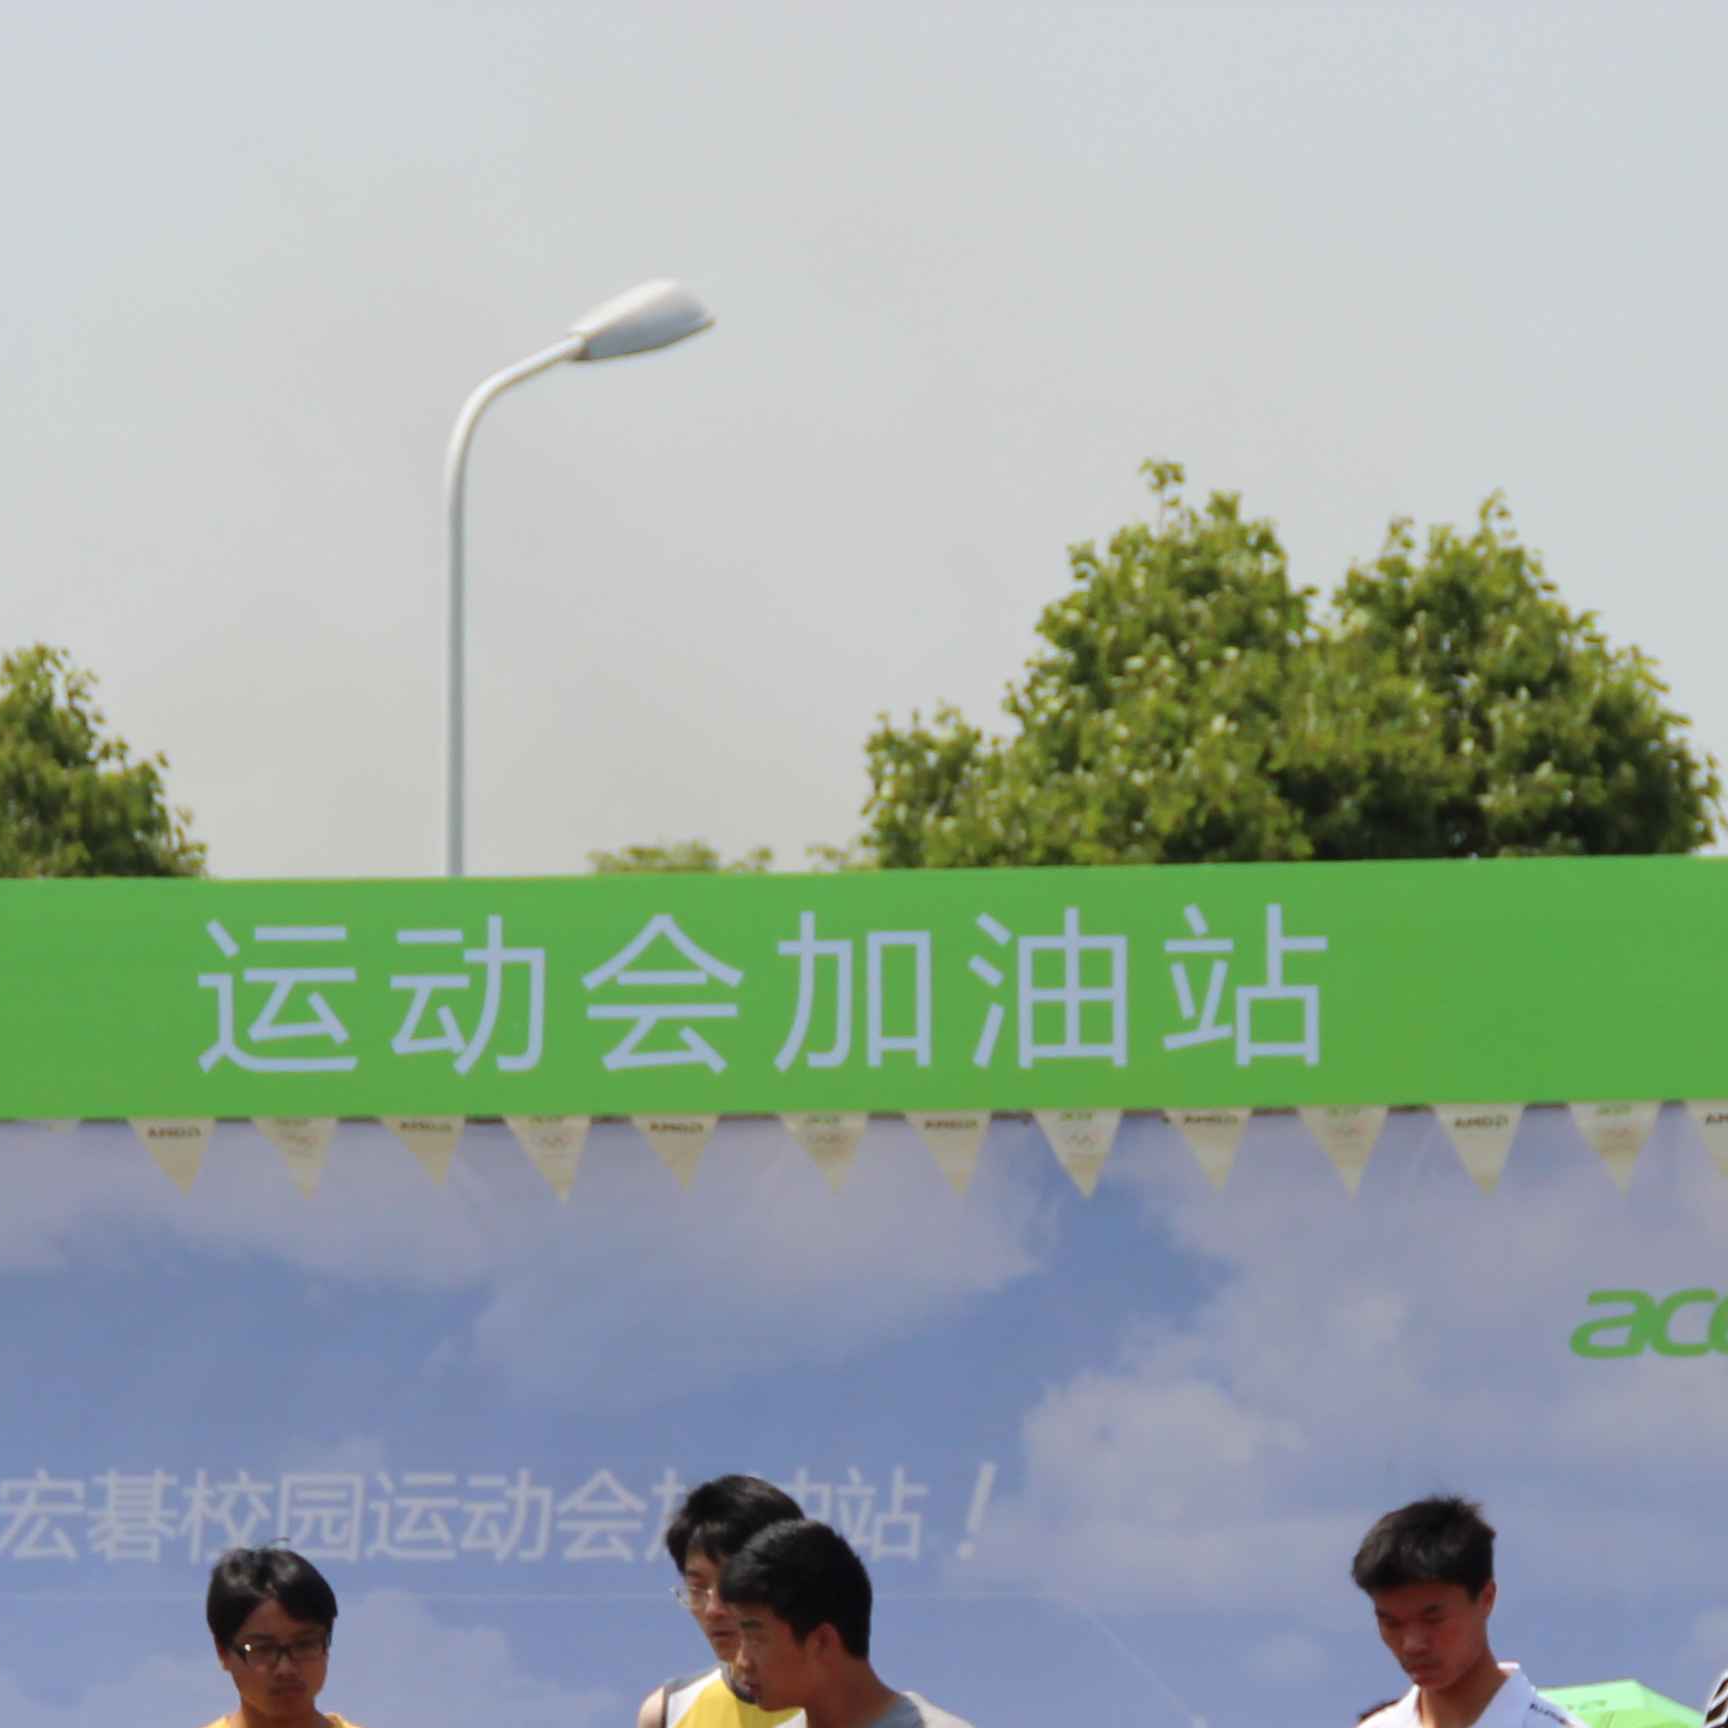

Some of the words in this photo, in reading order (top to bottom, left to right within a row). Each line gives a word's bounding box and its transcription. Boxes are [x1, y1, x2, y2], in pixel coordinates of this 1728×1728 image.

[197, 903, 1330, 1075] 运动会加油站
